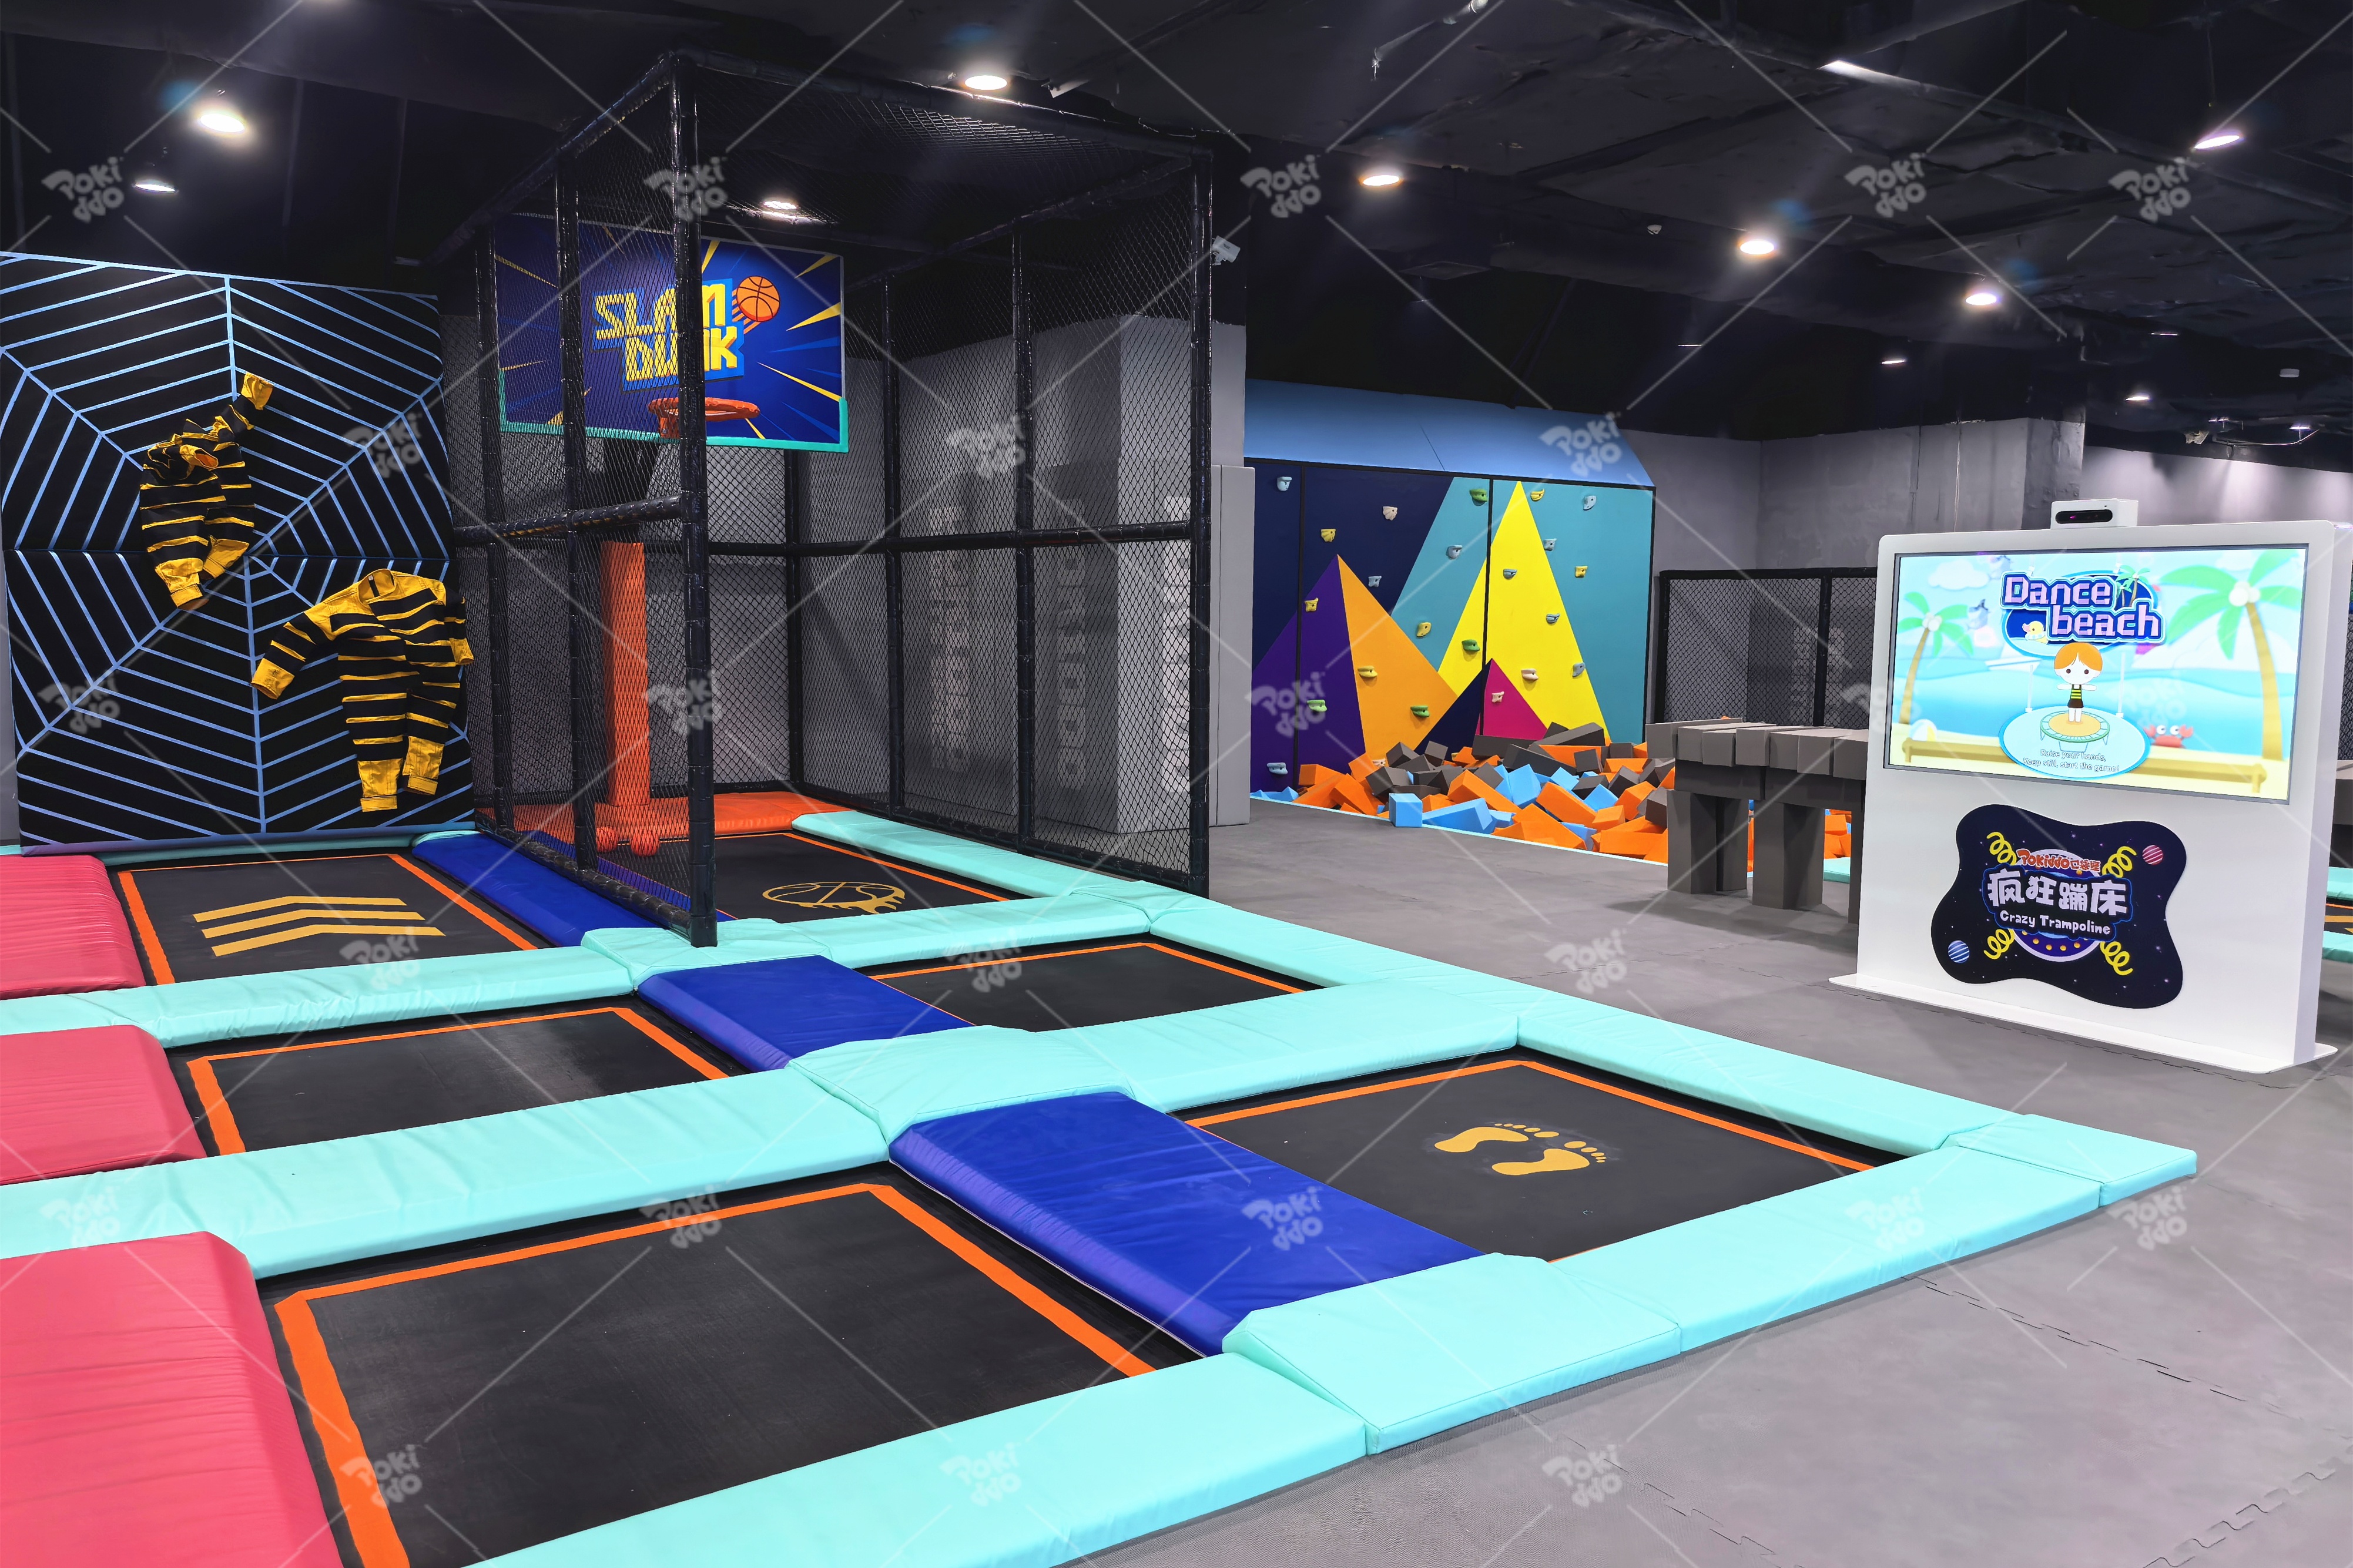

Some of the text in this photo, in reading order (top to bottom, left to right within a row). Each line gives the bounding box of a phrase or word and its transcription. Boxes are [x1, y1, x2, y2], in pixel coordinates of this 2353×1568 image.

[625, 325, 738, 382] DUK
[2004, 576, 2111, 605] Dance
[2052, 605, 2159, 636] beach
[2023, 757, 2042, 767] Keep
[2080, 762, 2093, 770] the
[2040, 749, 2060, 758] Raise
[2081, 753, 2107, 762] hands,
[1987, 868, 2127, 915] 疯狂蹦床
[1999, 910, 2111, 935] Crazy Trampoline
